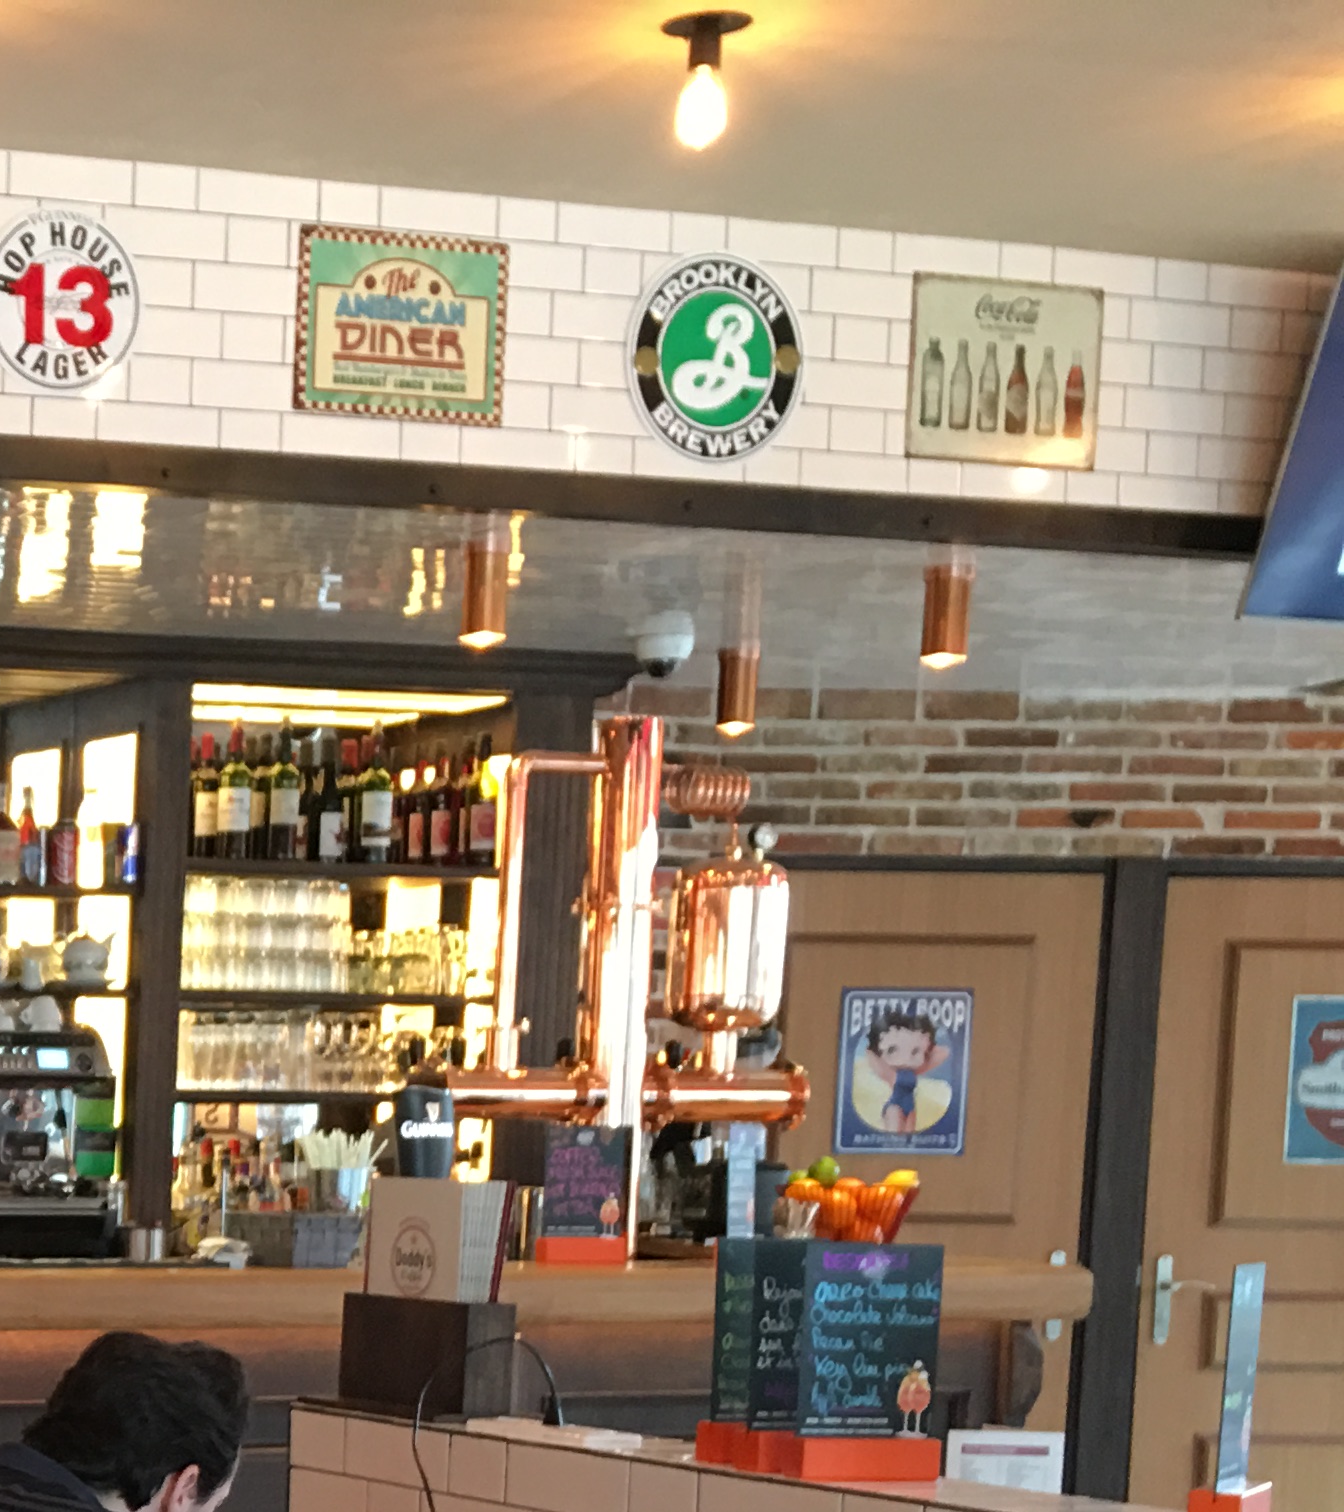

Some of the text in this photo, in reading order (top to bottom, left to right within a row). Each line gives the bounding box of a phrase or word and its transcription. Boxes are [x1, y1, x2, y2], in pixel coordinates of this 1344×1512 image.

[49, 221, 131, 299] HOUSE
[8, 262, 115, 348] 13
[335, 291, 467, 327] AMERICAN
[650, 263, 784, 323] BROOKLYN
[14, 342, 109, 380] LAGER
[334, 321, 465, 361] DINER
[652, 400, 782, 456] BREWERY
[850, 998, 966, 1037] BETTY BOOP
